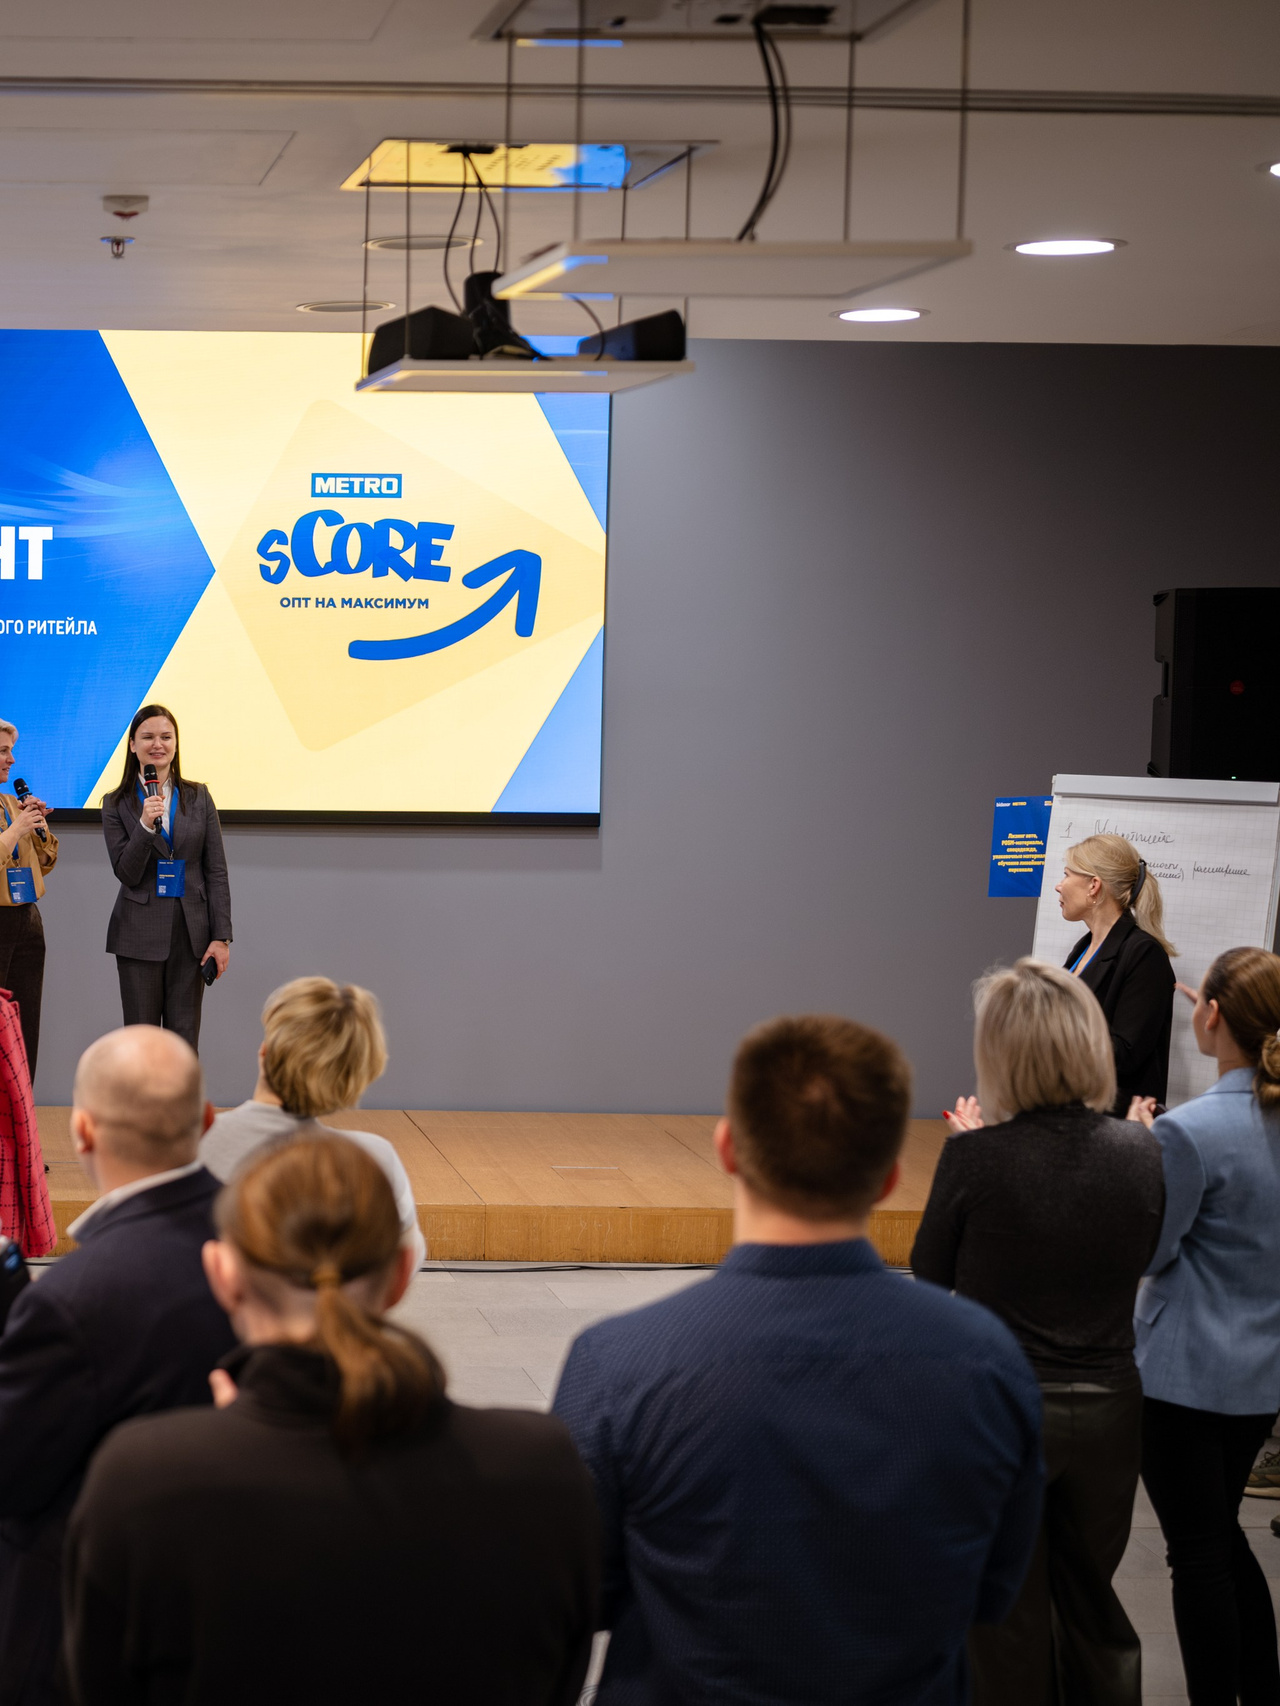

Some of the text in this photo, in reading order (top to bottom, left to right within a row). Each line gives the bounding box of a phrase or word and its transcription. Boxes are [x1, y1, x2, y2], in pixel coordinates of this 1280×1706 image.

[315, 477, 399, 494] METRO
[280, 597, 429, 609] ОПТ НА МАКСИМУМ
[27, 616, 98, 635] РИТЕЙЛА
